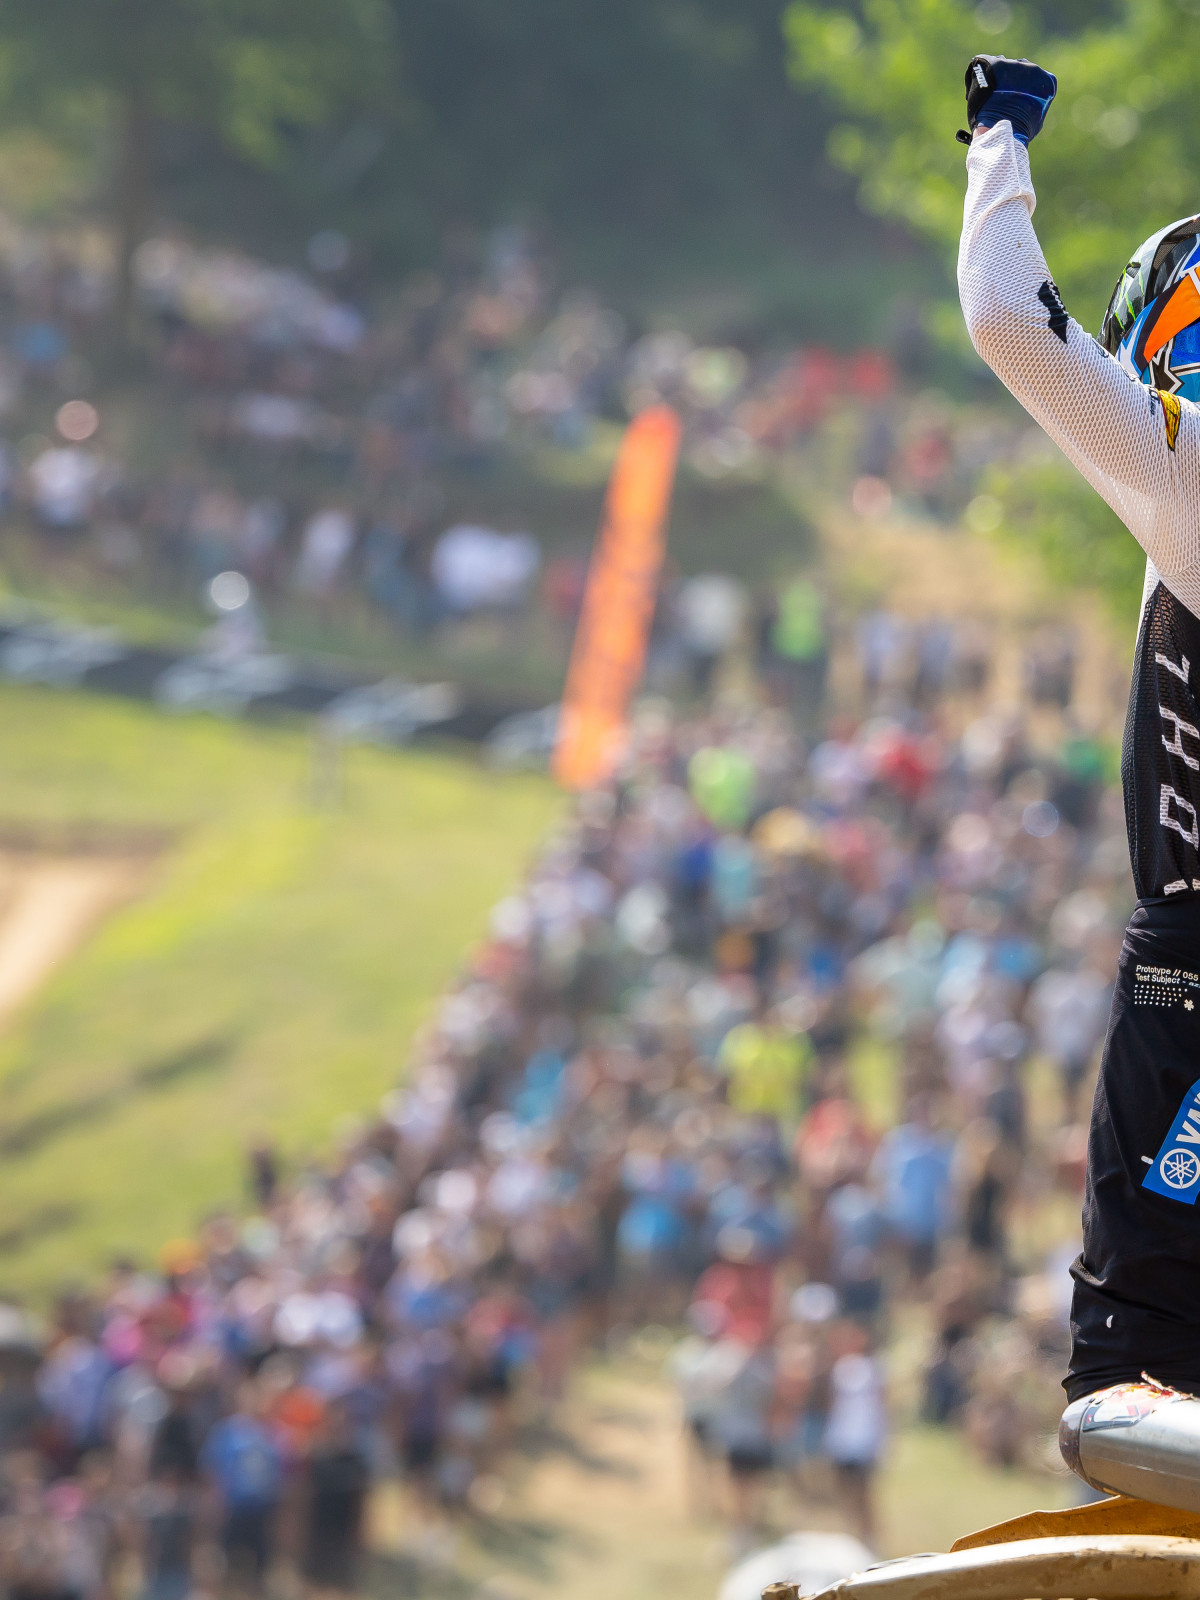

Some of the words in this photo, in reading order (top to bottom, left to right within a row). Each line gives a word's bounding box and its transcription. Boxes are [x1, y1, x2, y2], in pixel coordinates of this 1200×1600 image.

[973, 64, 989, 89] THOR
[1136, 964, 1171, 977] Prototype
[1136, 973, 1150, 981] Test
[1151, 974, 1180, 985] Subject
